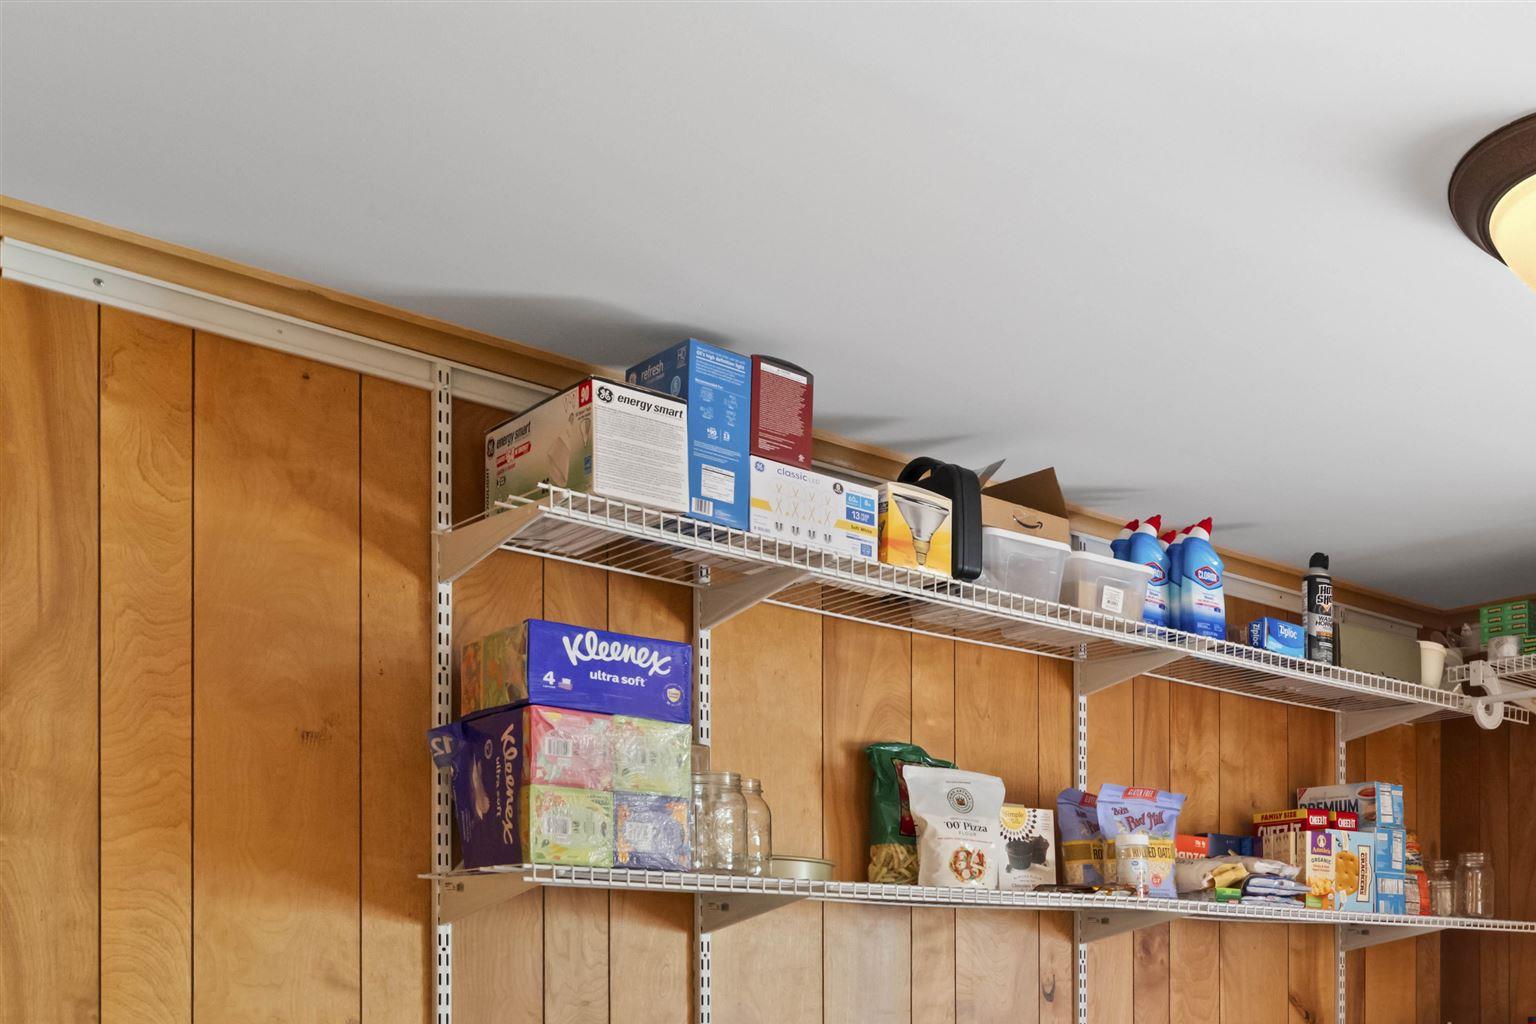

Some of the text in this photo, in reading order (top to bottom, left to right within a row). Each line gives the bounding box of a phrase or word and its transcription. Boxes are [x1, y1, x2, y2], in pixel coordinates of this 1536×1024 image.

[640, 360, 665, 379] refresh
[617, 394, 653, 412] energy
[653, 404, 684, 418] smart
[496, 421, 531, 449] energy smart
[777, 468, 808, 482] classic
[1279, 624, 1298, 640] Ziploc
[562, 631, 672, 676] Kleenex
[542, 671, 556, 685] 4
[589, 670, 646, 687] ultra soft
[501, 723, 518, 845] Kleenex
[1125, 810, 1166, 832] Red Mill
[1261, 811, 1297, 820] FAMILY SIZE
[963, 822, 988, 832] Pizza
